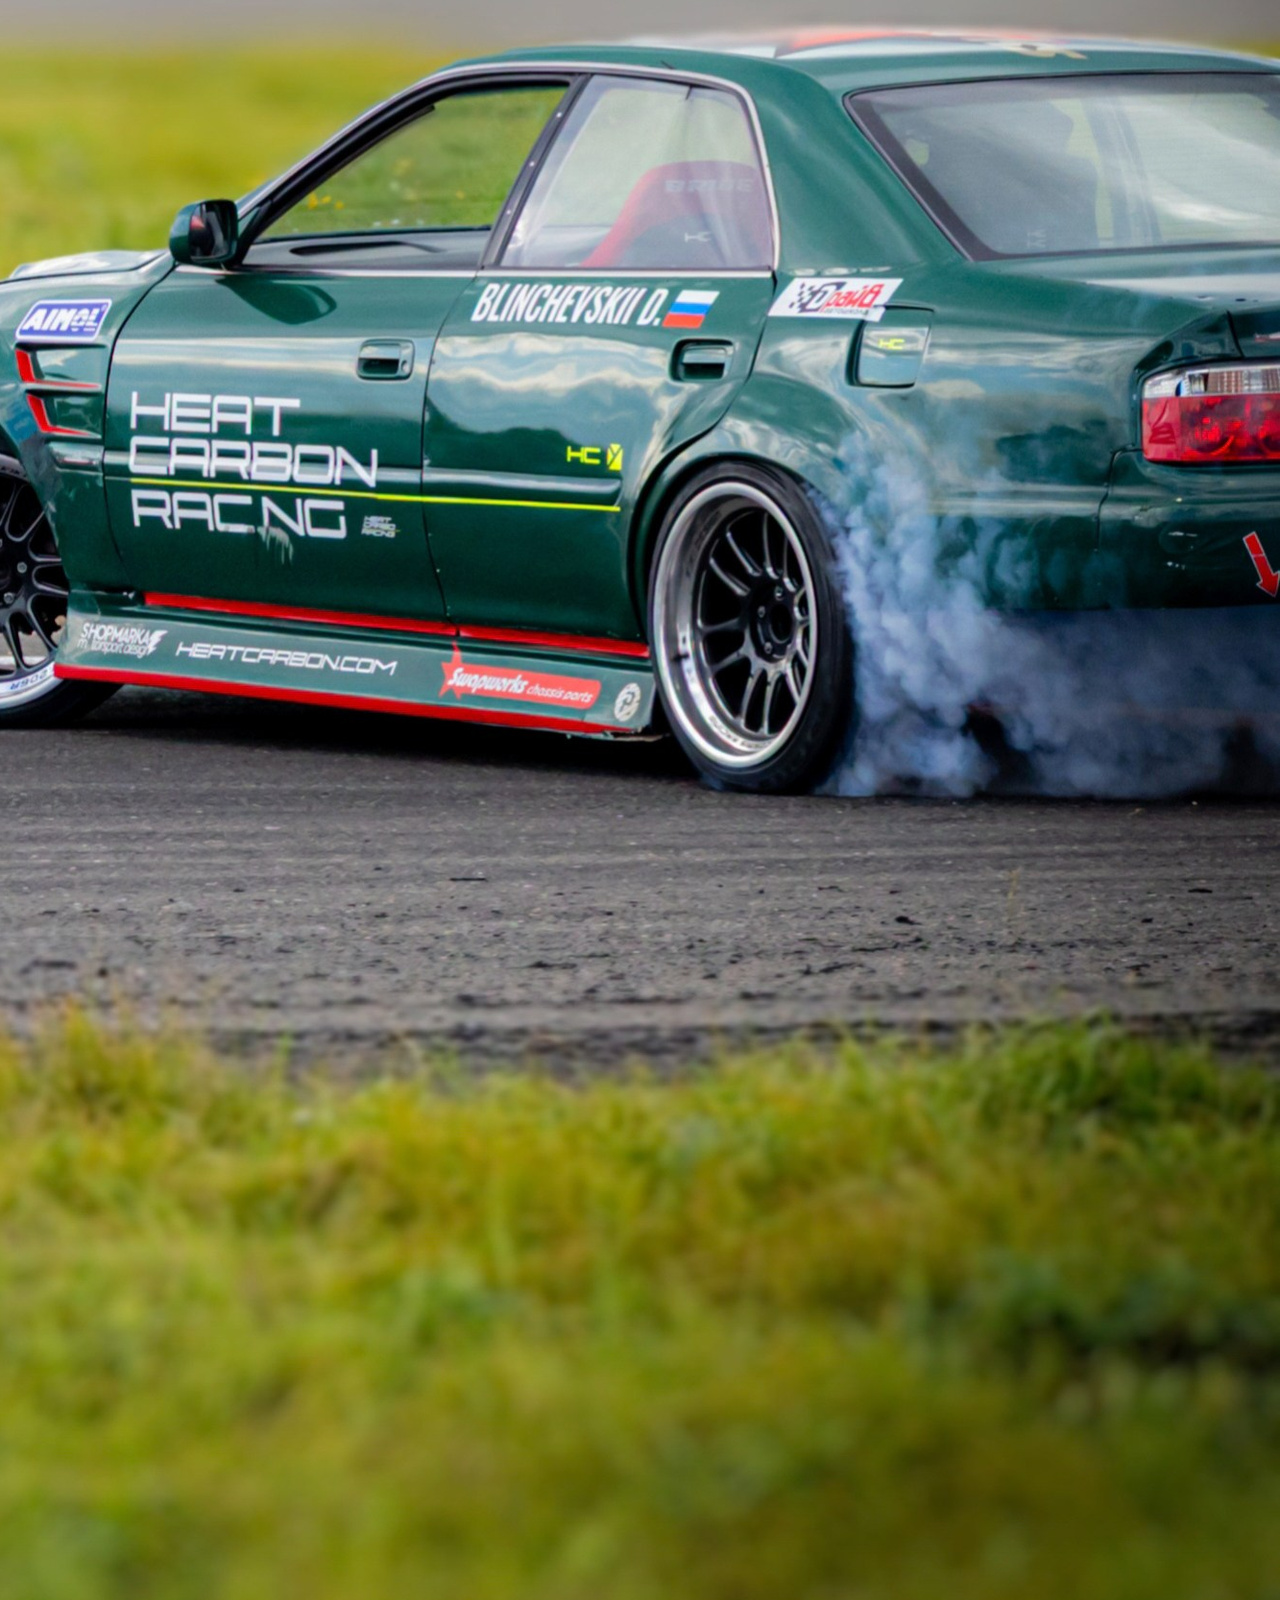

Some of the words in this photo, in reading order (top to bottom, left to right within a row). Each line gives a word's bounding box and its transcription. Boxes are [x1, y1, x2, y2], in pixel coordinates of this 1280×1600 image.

[22, 308, 100, 332] AIMOL
[471, 283, 648, 325] BLINCHEVSKII
[636, 288, 669, 327] D.
[130, 391, 301, 436] HEAT
[128, 436, 378, 488] CARBON
[566, 445, 601, 465] HC
[131, 489, 348, 539] RACNG
[81, 622, 151, 646] SHOPMARKA
[175, 642, 398, 676] HEATCARBON.COM
[447, 667, 529, 693] Swapworks
[526, 686, 565, 699] chassis
[563, 691, 594, 703] parts
